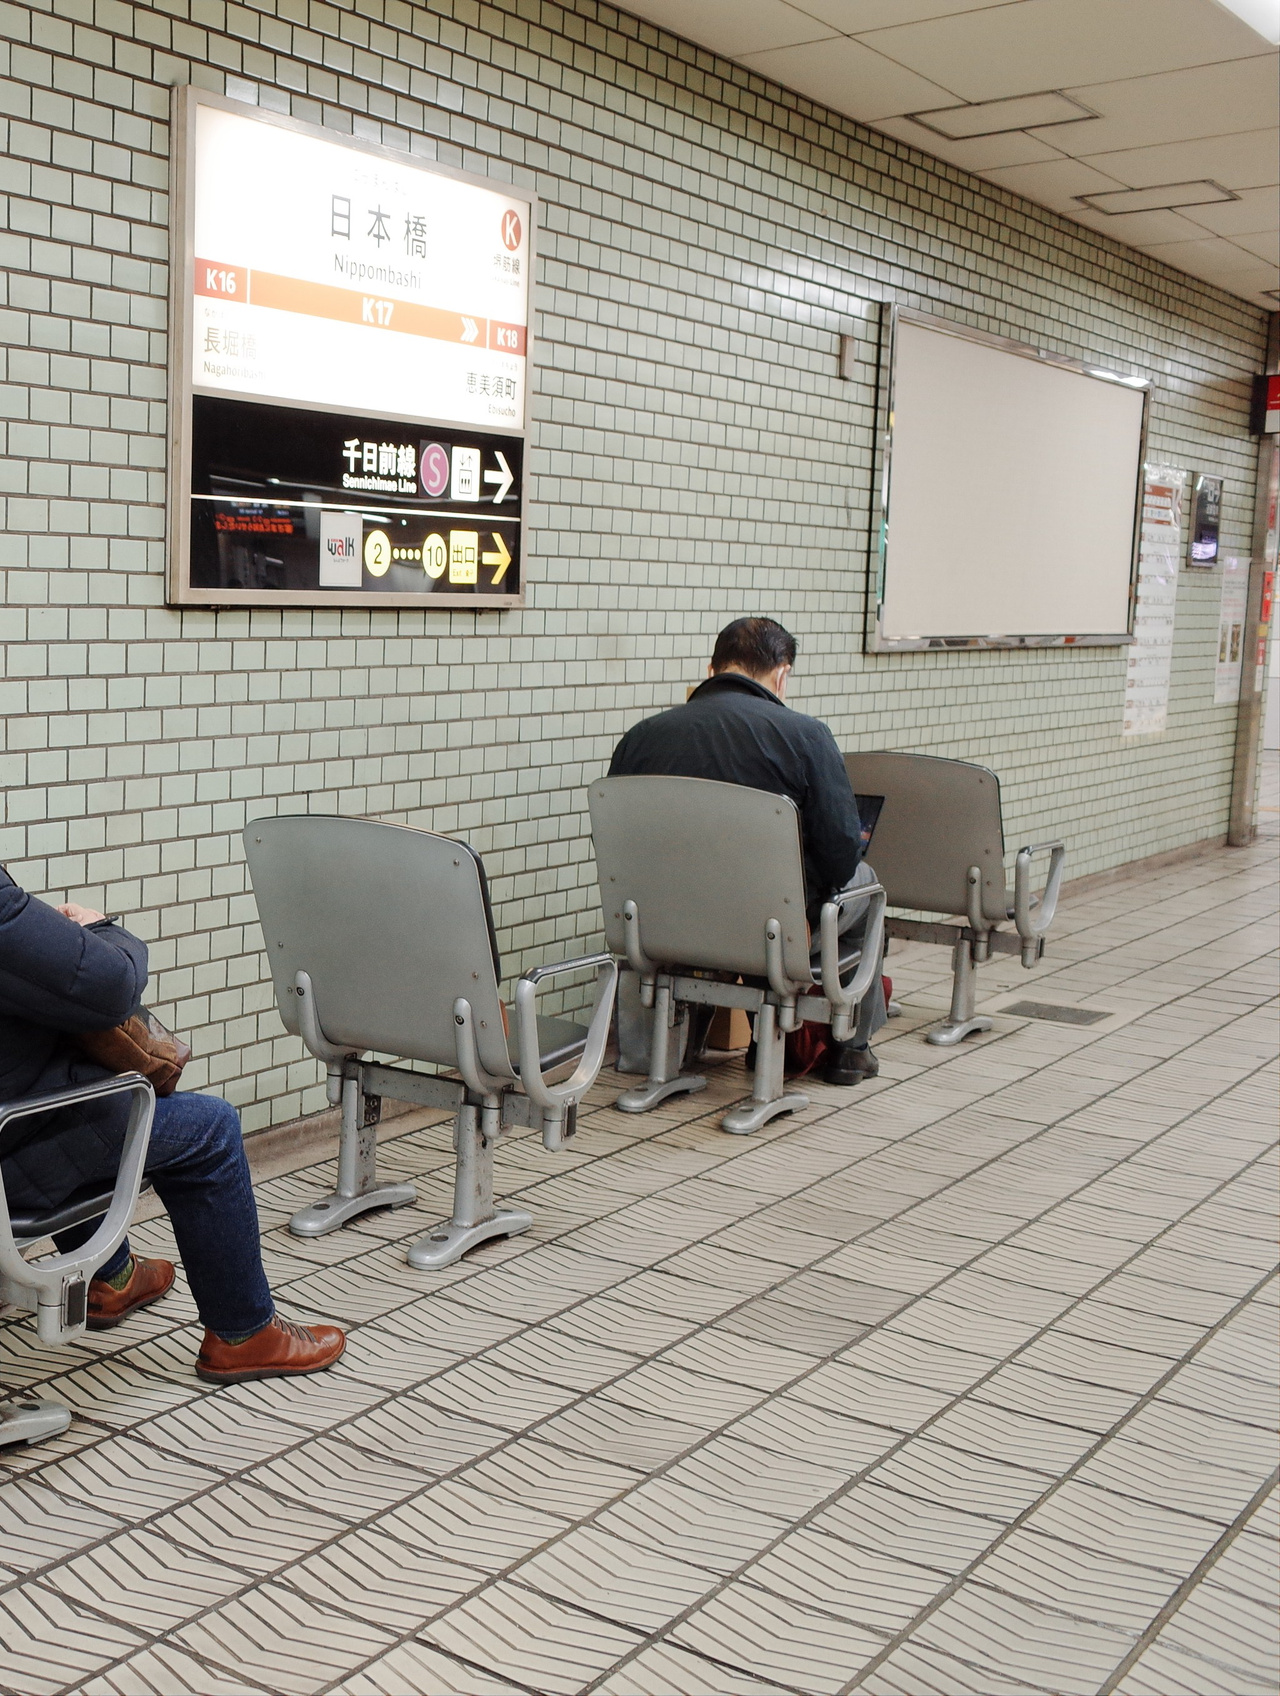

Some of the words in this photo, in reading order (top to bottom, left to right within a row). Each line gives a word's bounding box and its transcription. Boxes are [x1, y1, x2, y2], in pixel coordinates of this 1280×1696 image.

[331, 194, 427, 259] 日本橋
[505, 213, 518, 248] K
[205, 268, 237, 295] K16
[333, 253, 423, 289] Nippombashi
[362, 296, 395, 327] K17
[203, 326, 257, 360] 長堀橋
[496, 326, 518, 349] K18
[465, 371, 517, 401] 恵美須町
[342, 438, 417, 478] 千日前線
[342, 472, 396, 493] Sennichimae
[398, 478, 417, 494] Line
[373, 543, 383, 565] 2
[427, 545, 443, 567] 10
[452, 544, 475, 564] 出口
